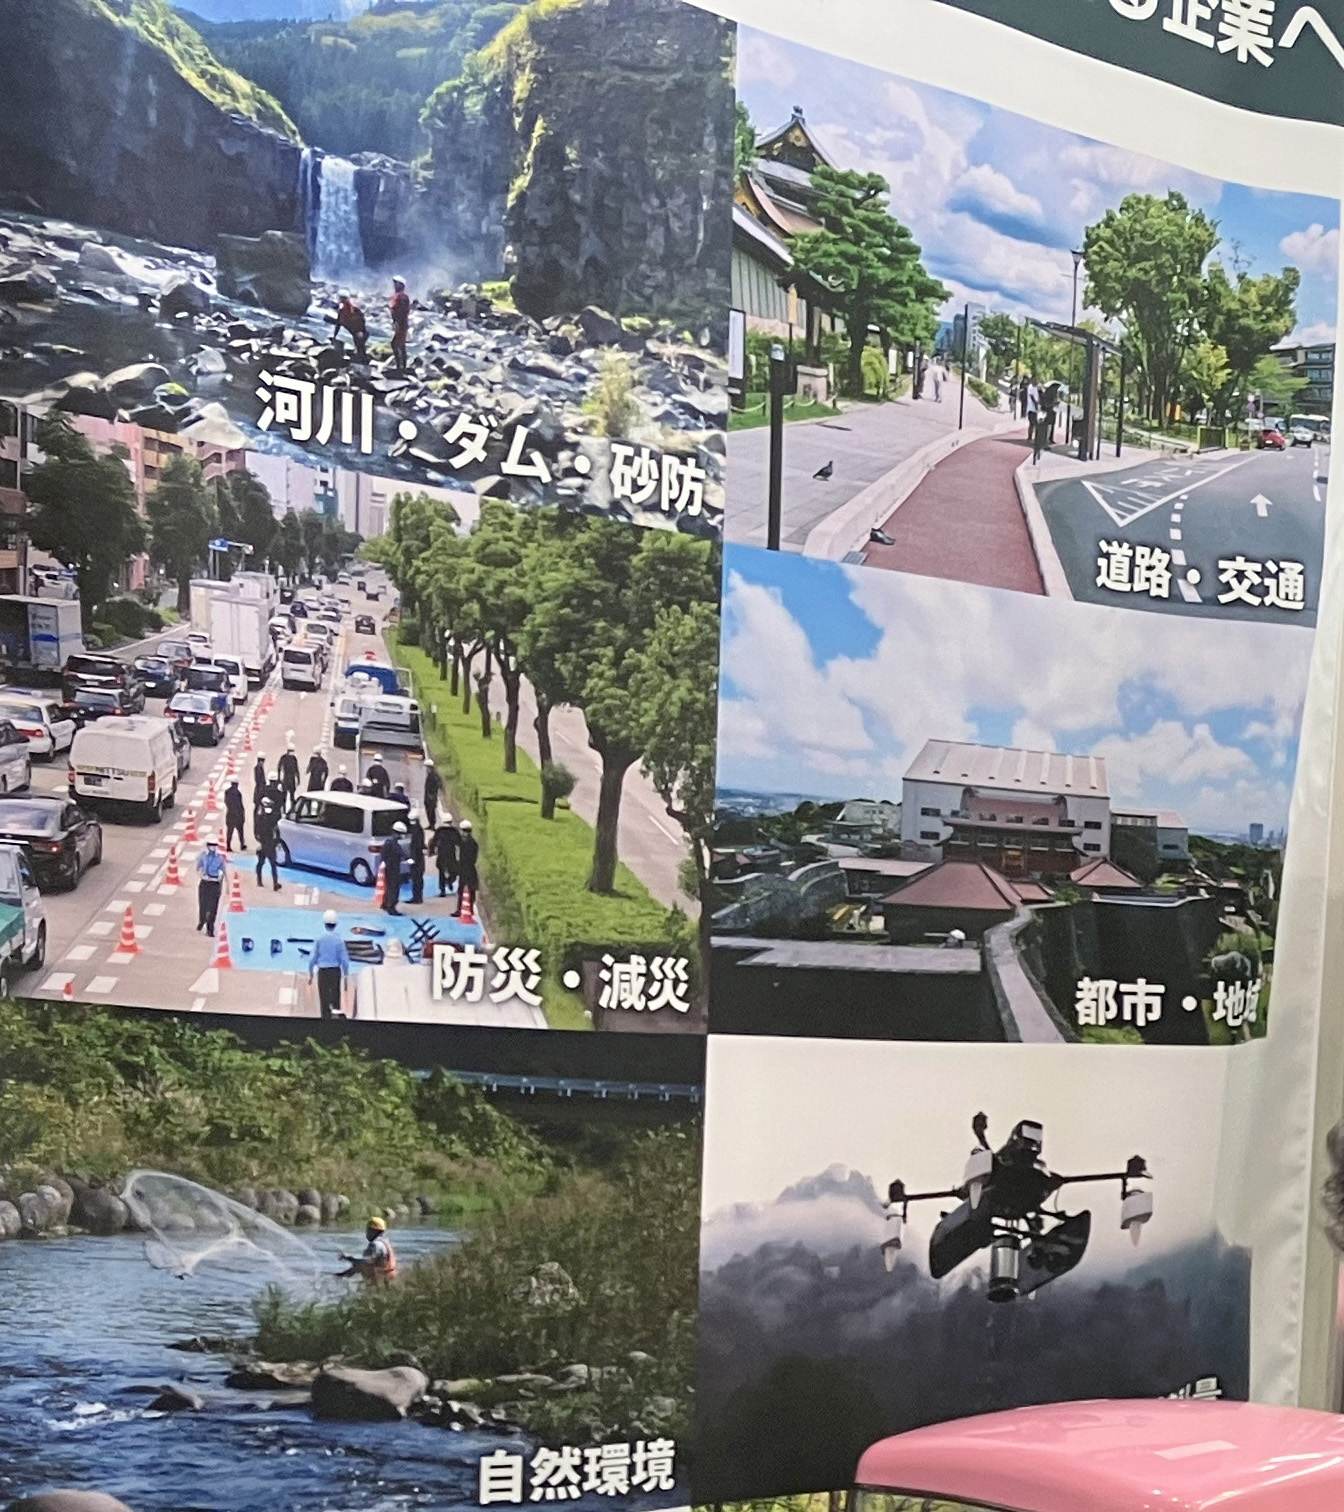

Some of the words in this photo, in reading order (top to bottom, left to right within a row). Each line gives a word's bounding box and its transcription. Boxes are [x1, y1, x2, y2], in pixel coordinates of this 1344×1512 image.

[255, 369, 706, 516] 河川・ダム・砂防
[1096, 540, 1306, 609] 道路・交通
[433, 944, 691, 1013] 防災・減災
[479, 1438, 674, 1505] 自然環境
